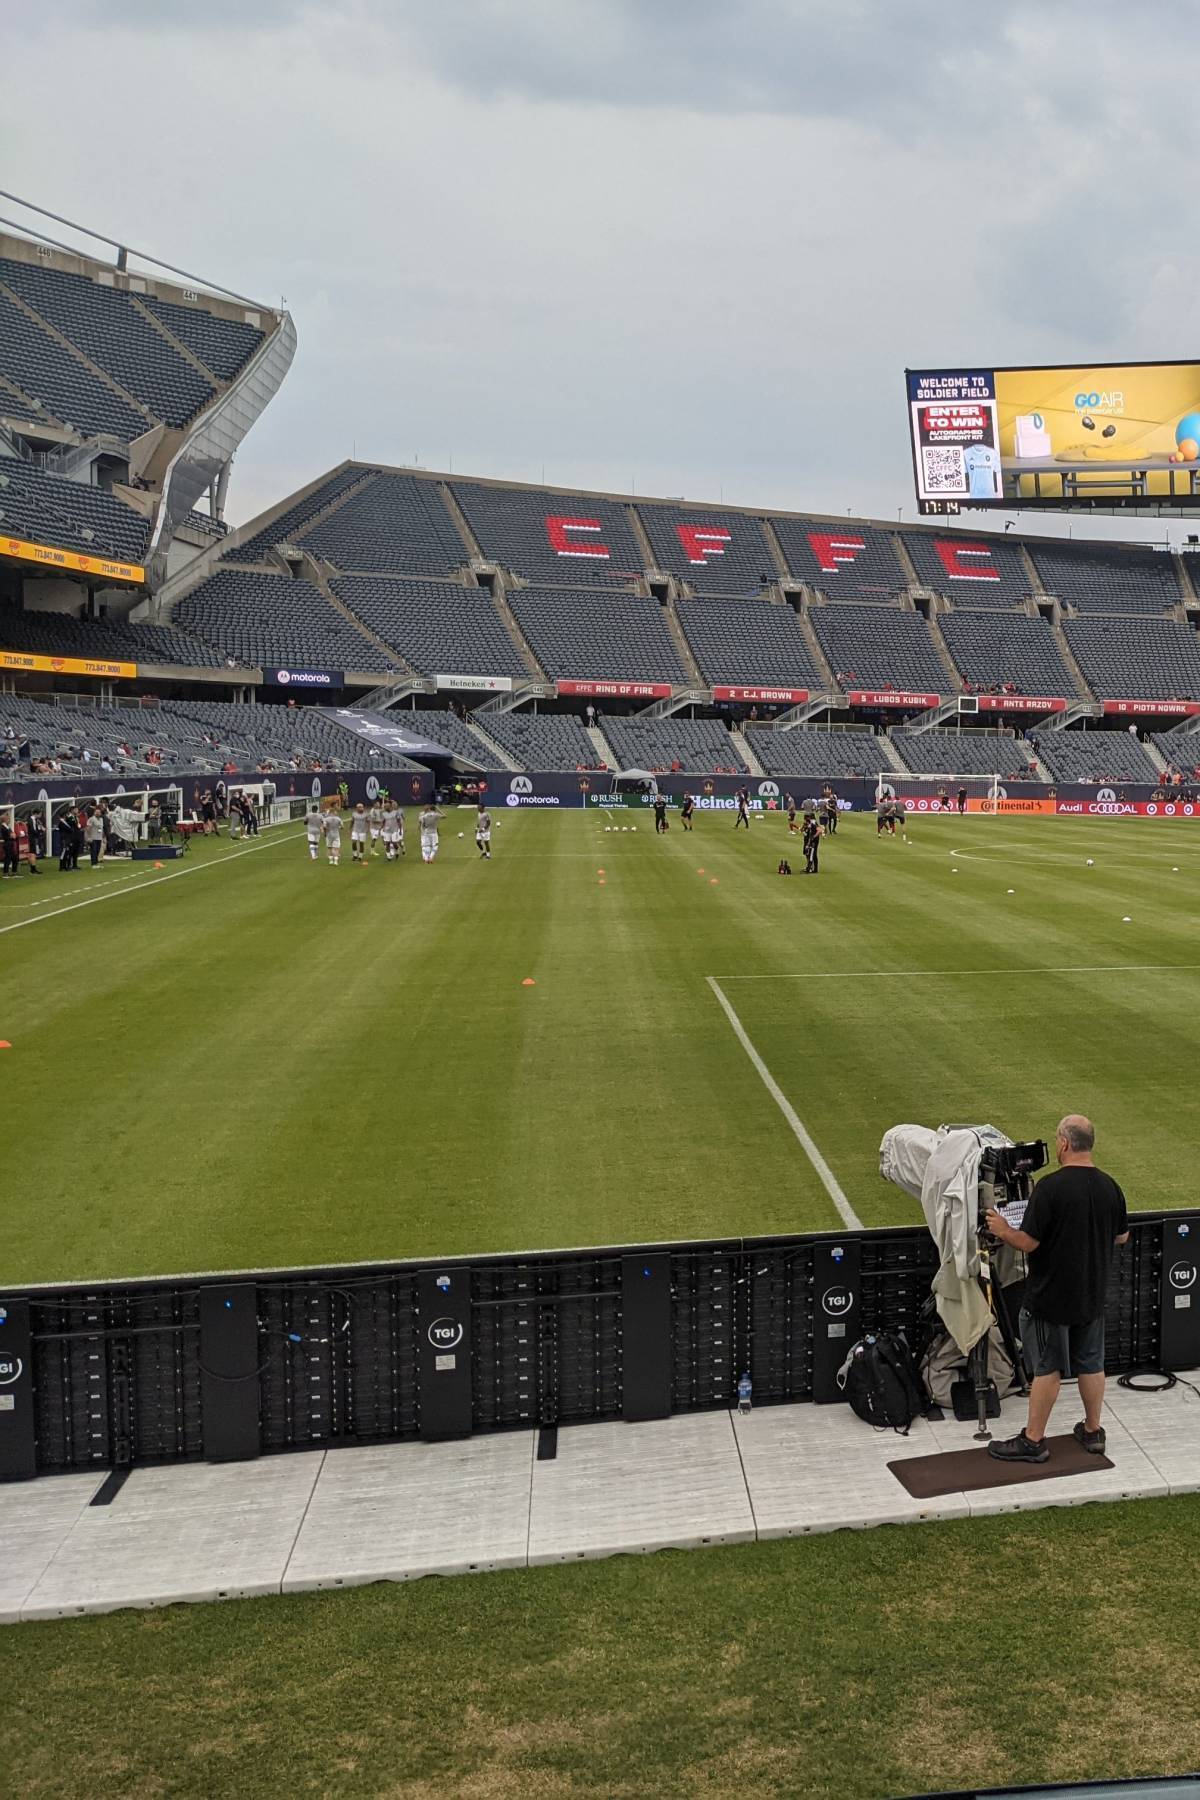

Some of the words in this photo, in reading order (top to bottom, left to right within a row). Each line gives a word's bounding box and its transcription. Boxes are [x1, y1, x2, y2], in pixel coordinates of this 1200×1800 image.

[920, 377, 968, 388] WELCOME
[972, 377, 985, 387] TO
[917, 388, 958, 399] SOLDIER
[961, 387, 989, 398] FIELD
[929, 406, 980, 417] ENTER
[926, 418, 949, 428] TO
[951, 416, 984, 427] WIN
[925, 501, 959, 514] 17:14
[291, 673, 330, 683] motorola
[449, 679, 486, 688] Heineken
[596, 685, 617, 694] RING
[620, 686, 631, 694] OF
[634, 687, 654, 695] FIRE
[729, 690, 736, 698] 2
[743, 690, 759, 698] C.J.
[760, 691, 792, 700] BROWN
[873, 695, 901, 704] LUBOS
[902, 696, 927, 705] KUBIK
[1003, 700, 1024, 708] ANTE
[1025, 700, 1052, 709] RAZOV
[1118, 703, 1127, 711] 10
[1133, 704, 1156, 712] PIOTR
[1158, 704, 1187, 713] NOWAK
[520, 796, 559, 805] motorola
[599, 794, 622, 803] RUSH
[1059, 803, 1082, 812] Audi
[1174, 1269, 1190, 1281] TGI
[827, 1294, 846, 1307] TGI
[434, 1328, 455, 1339] TGI
[0, 1362, 13, 1374] GI
